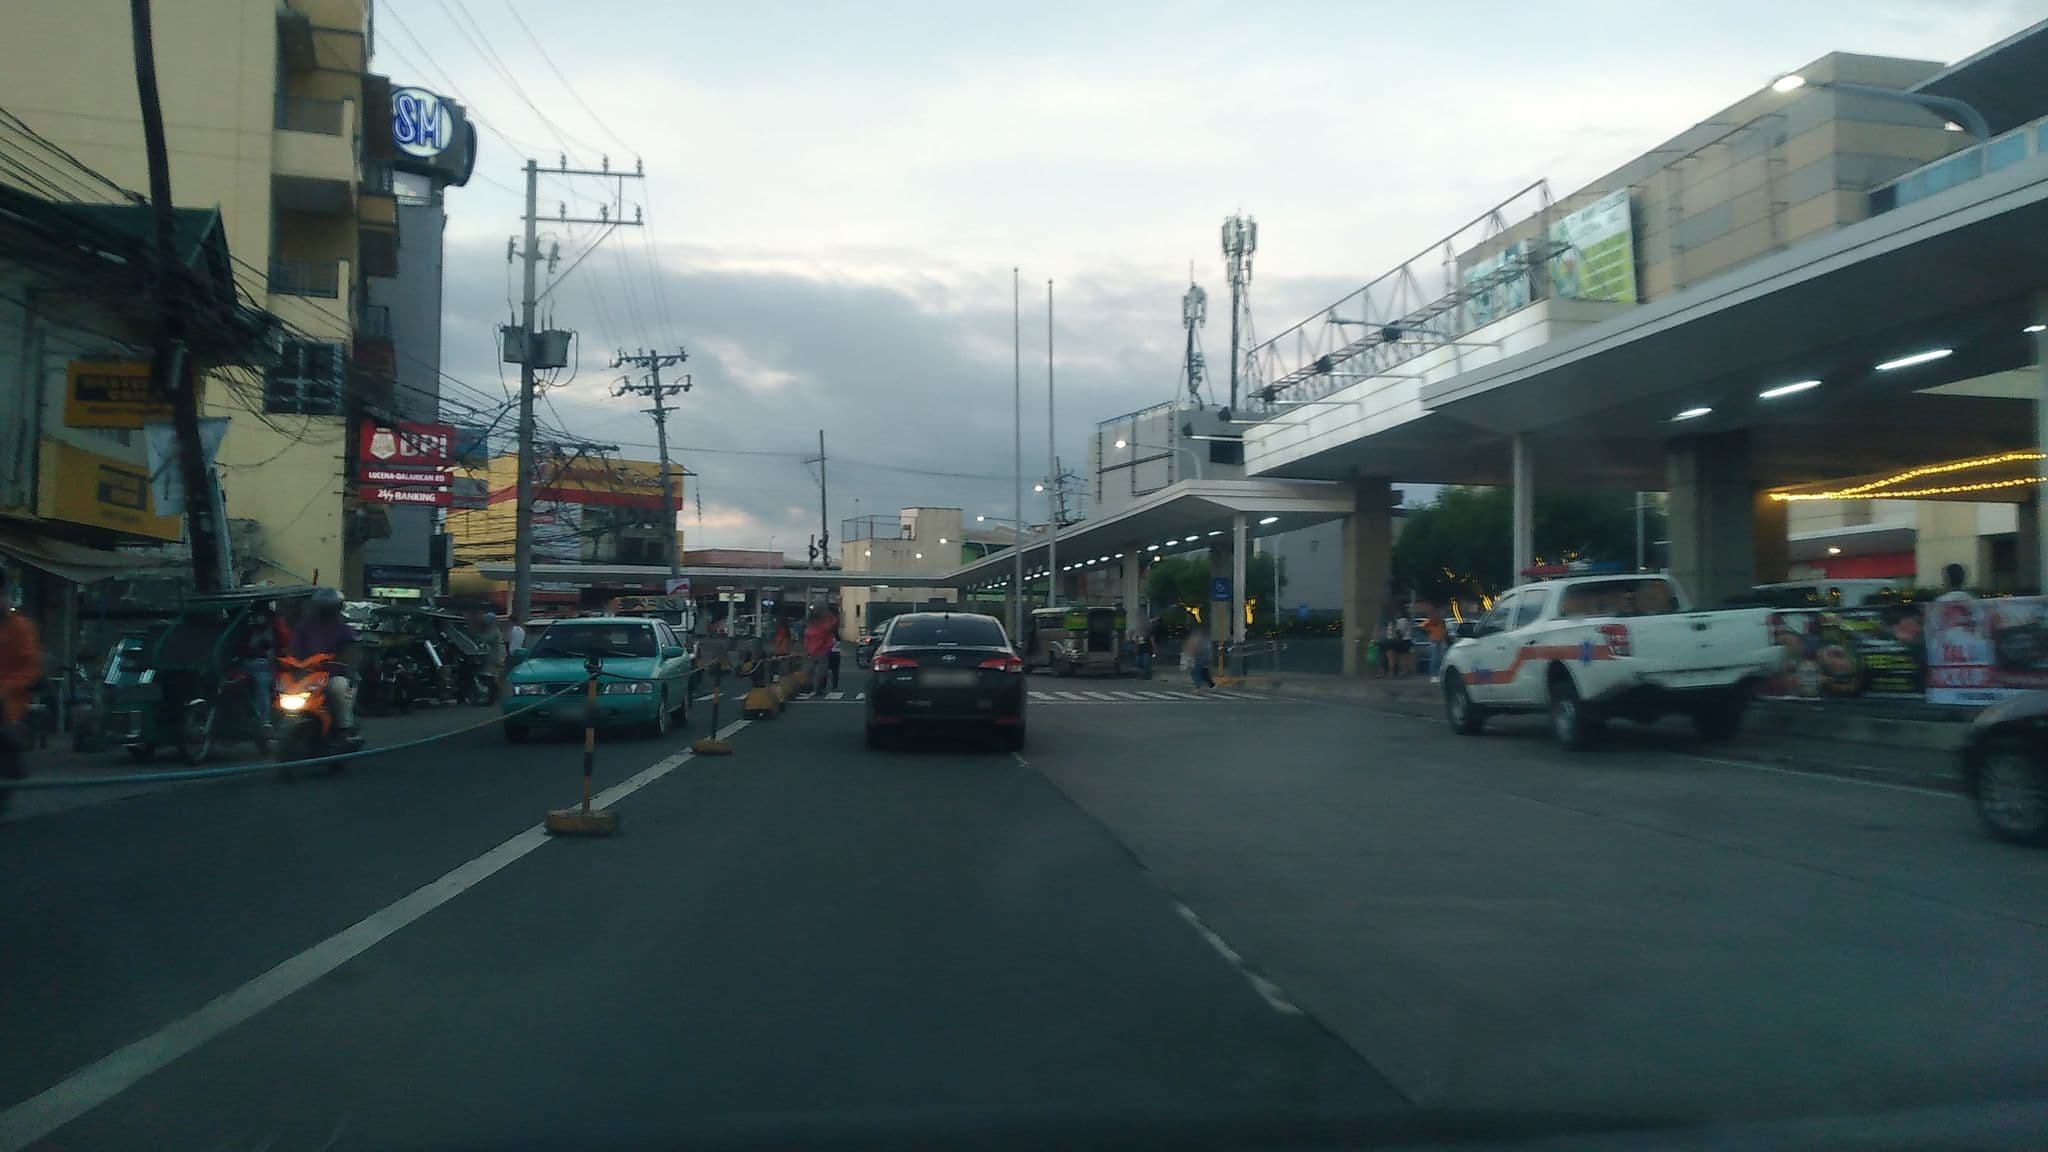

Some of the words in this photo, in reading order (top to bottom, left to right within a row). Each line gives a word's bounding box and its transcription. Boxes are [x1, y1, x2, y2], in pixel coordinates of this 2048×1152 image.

[392, 94, 442, 149] SM
[400, 431, 447, 459] BPI
[377, 488, 394, 501] 24/7
[394, 491, 436, 502] BANKING
